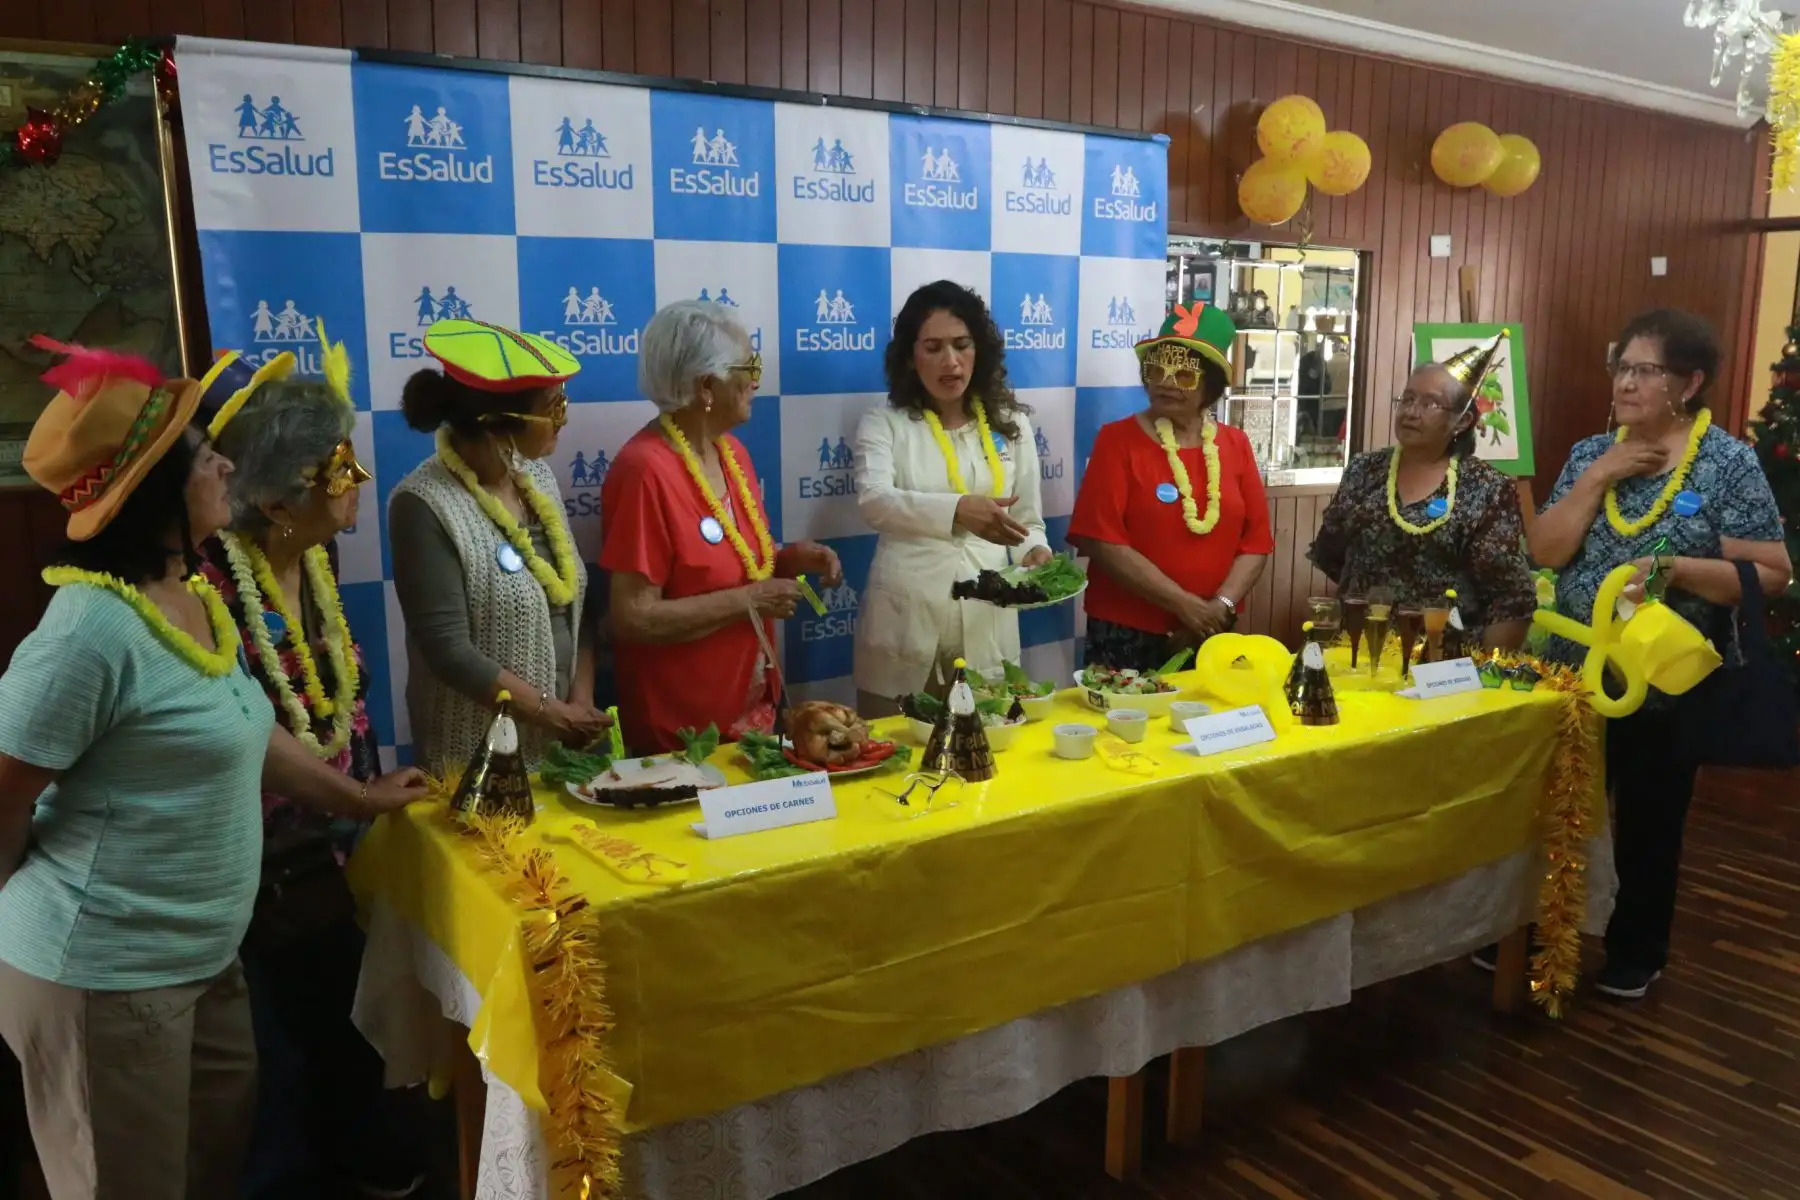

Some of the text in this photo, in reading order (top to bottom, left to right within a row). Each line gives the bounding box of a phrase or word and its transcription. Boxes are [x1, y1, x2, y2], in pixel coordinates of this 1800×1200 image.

[208, 143, 334, 177] EsSalud
[379, 152, 493, 184] EsSalud
[534, 160, 633, 190] EsSalud
[670, 168, 759, 197] EsSalud
[793, 176, 875, 203] EsSalud
[904, 183, 978, 210] EsSalud
[1005, 191, 1072, 215] EsSalud
[1095, 198, 1156, 222] EsSalud
[796, 327, 875, 351] EsSalud
[1003, 328, 1066, 350] EsSalud
[724, 796, 815, 818] OPCIONES DE CARNES
